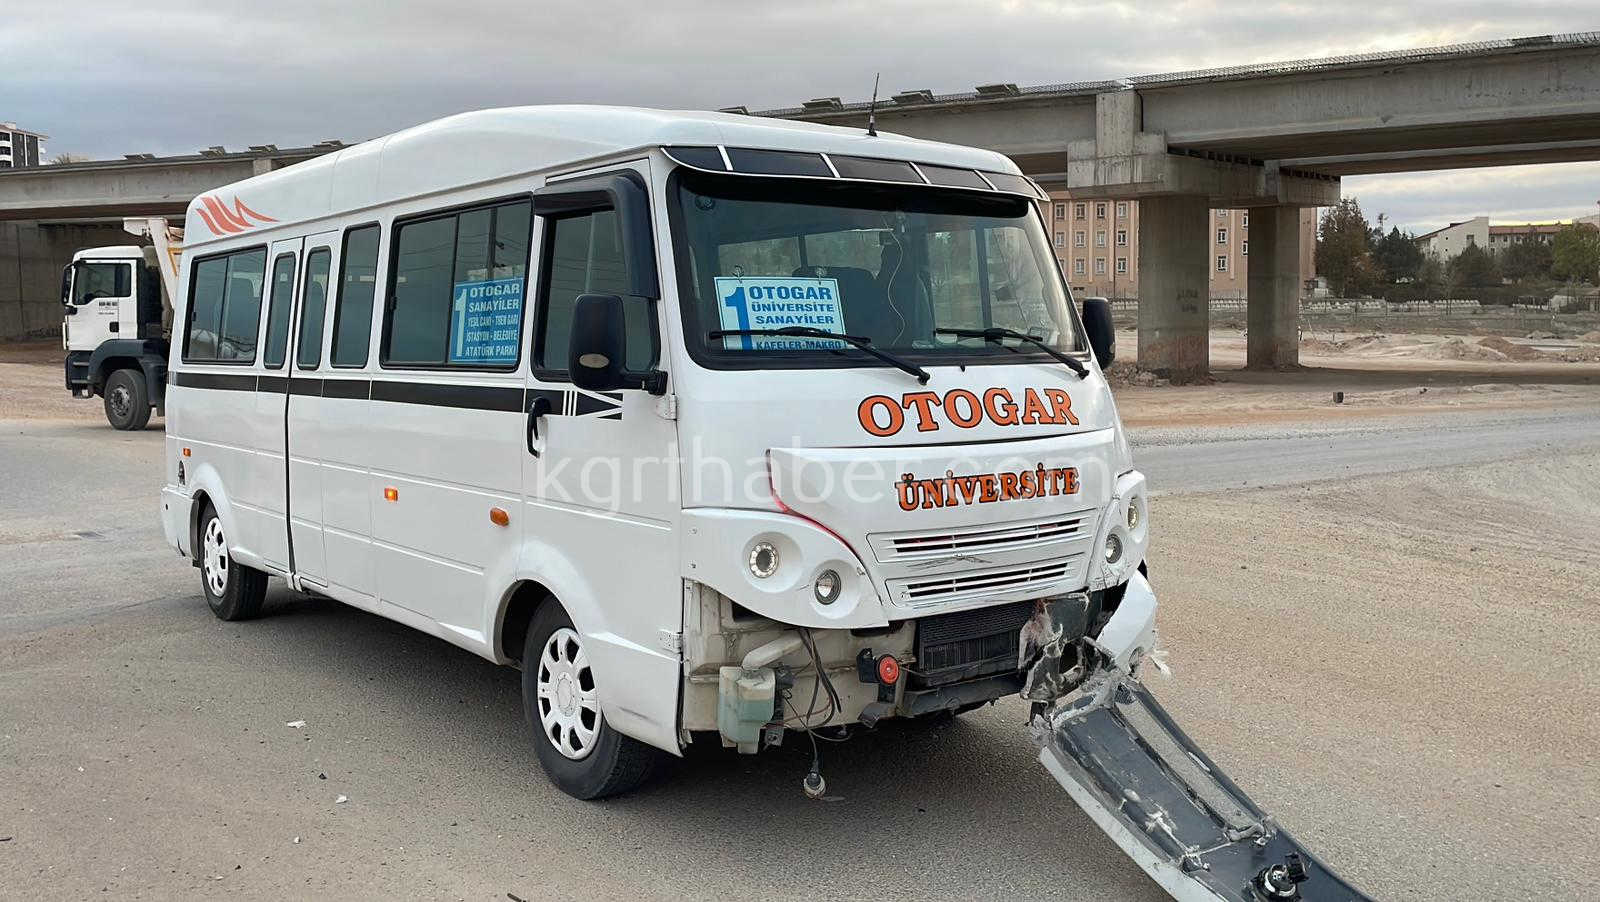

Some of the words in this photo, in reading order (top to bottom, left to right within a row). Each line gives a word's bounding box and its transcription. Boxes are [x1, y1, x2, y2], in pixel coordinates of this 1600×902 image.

[470, 283, 520, 298] OTOGAR
[748, 286, 832, 300] OTOGAR
[469, 298, 520, 313] SANAYİLER
[751, 301, 835, 313] ÜNİVERSİTE
[455, 288, 468, 357] 1
[724, 286, 753, 350] 1
[755, 314, 835, 324] SANAYİLER
[465, 343, 494, 357] ATATÜRK
[495, 344, 516, 356] PARKI
[858, 387, 1080, 437] OTOGAR
[895, 462, 1080, 511] ÜNİVERSİTE
